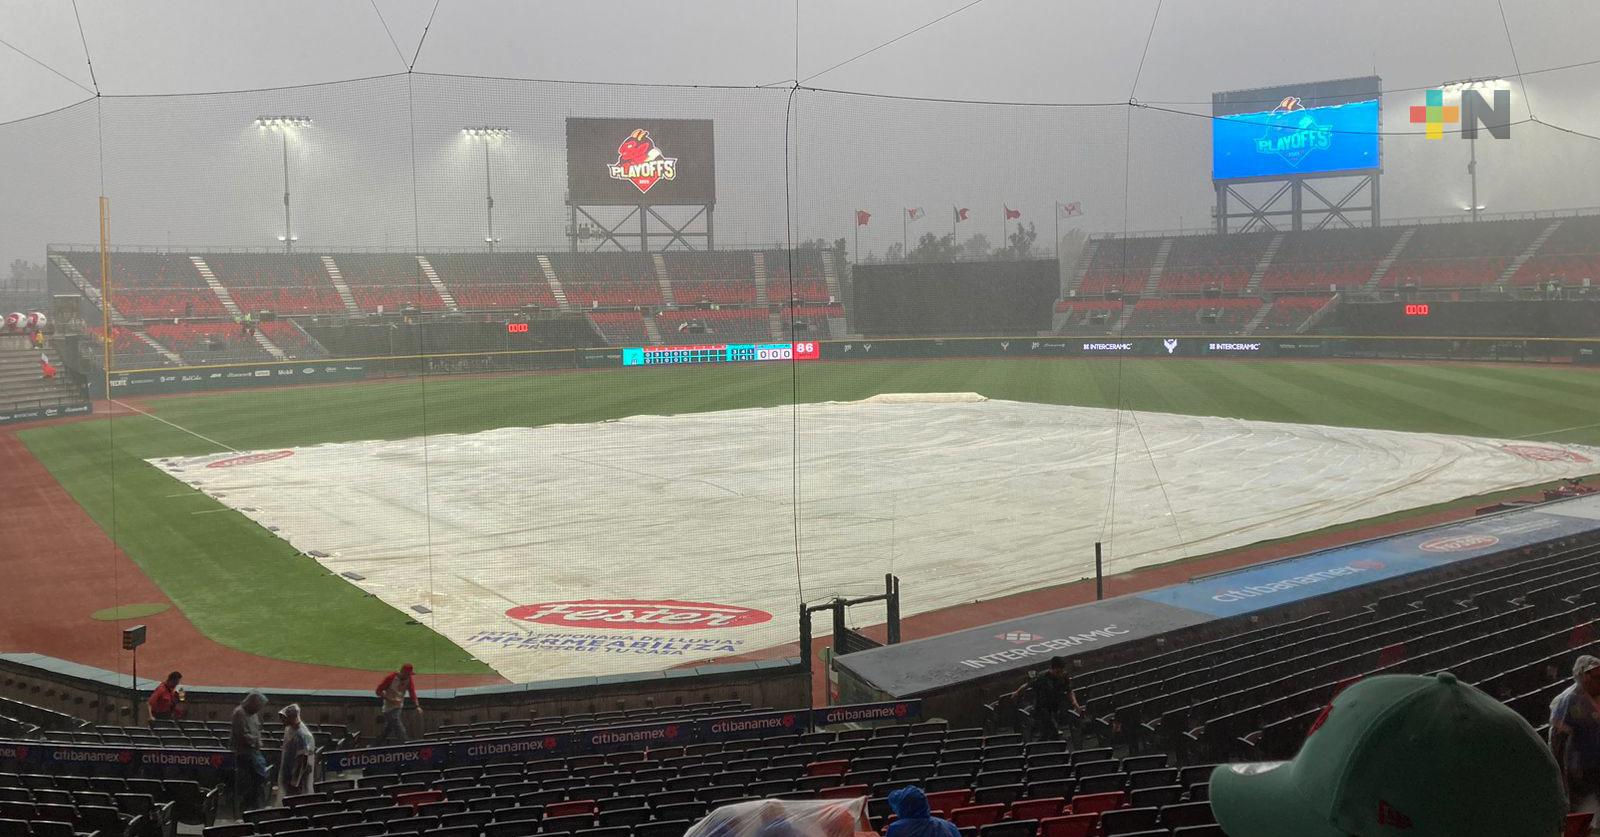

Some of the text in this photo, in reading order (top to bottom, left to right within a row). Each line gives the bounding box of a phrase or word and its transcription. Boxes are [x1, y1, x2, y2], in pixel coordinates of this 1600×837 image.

[1258, 128, 1329, 151] PLAYOFFS
[611, 160, 674, 178] PLAYOFFS
[796, 343, 813, 352] 86
[1212, 564, 1366, 602] citibanamex
[525, 602, 750, 626] Fester
[467, 635, 736, 652] IMPERMEABILIZA
[961, 625, 1130, 669] INTERCERAMIC
[827, 706, 895, 722] citibanamex
[711, 717, 782, 733] citibanamex
[592, 728, 665, 745] citibanamex
[53, 749, 119, 762] citibanamex
[467, 738, 544, 756] citibanamex
[142, 753, 210, 765] citibanamex
[340, 750, 419, 767] citibanamex
